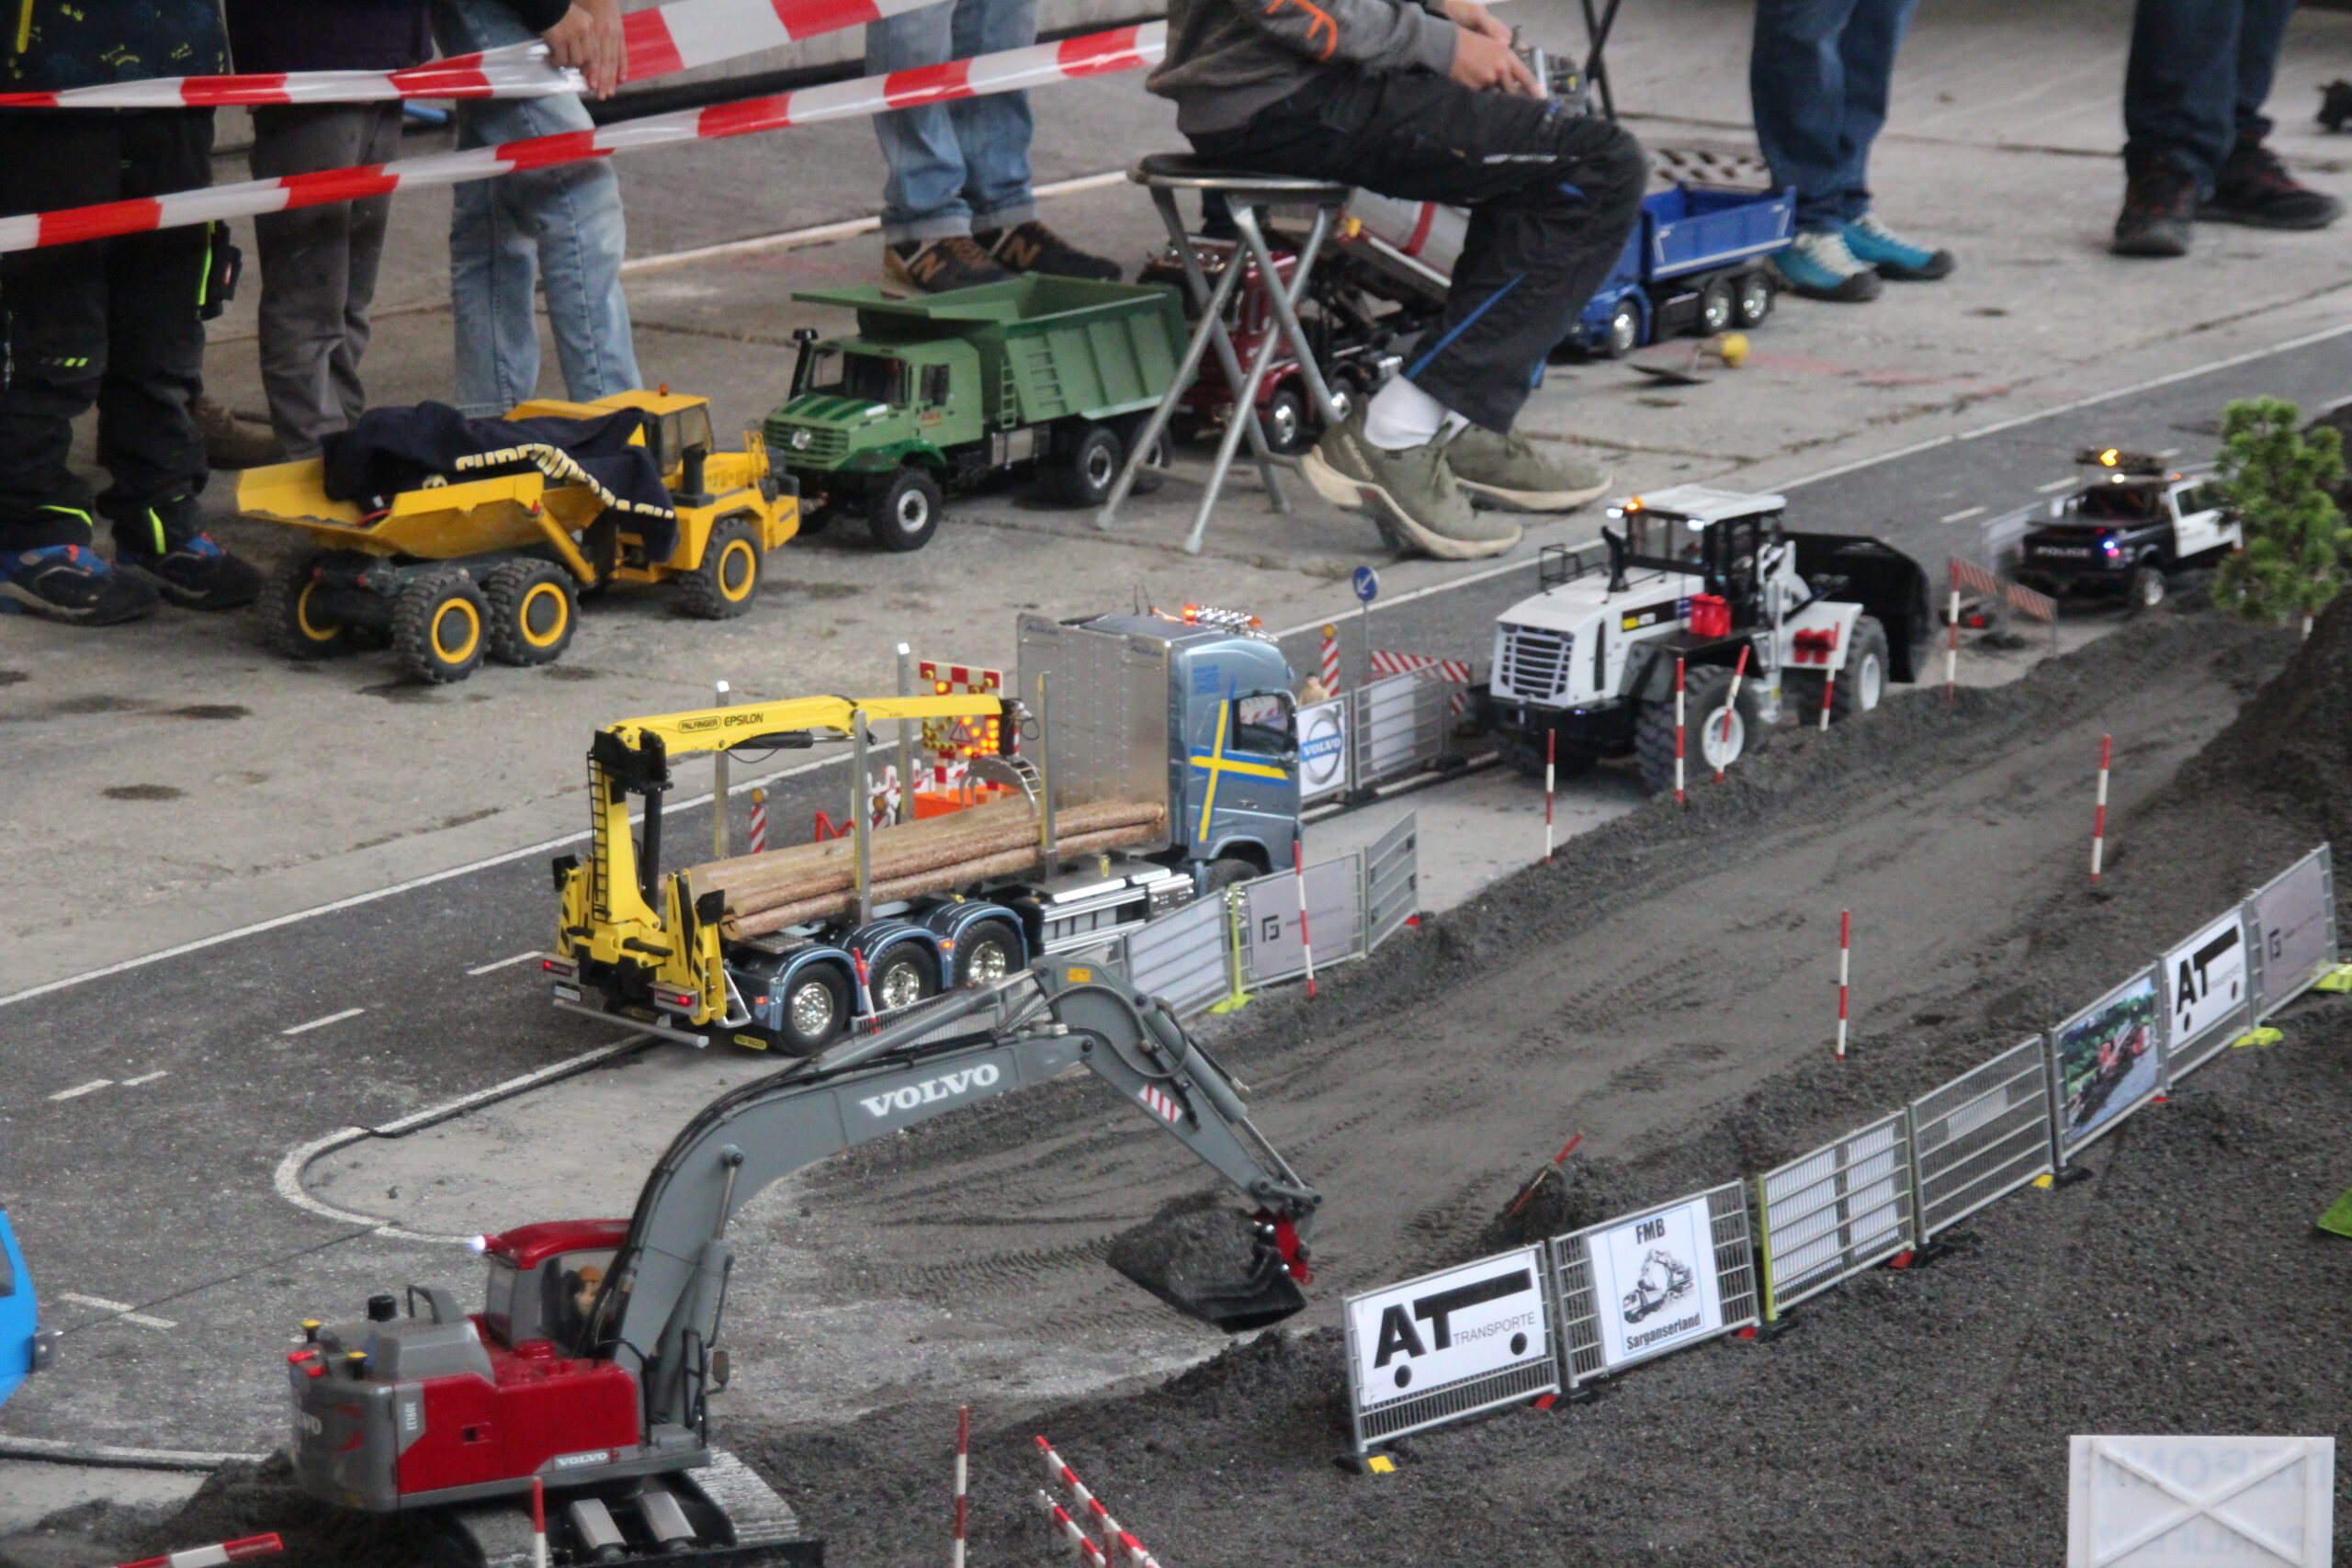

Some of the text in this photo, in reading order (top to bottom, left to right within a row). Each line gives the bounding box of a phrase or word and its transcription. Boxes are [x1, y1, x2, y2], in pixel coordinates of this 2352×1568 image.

[682, 713, 763, 730] PALFINGER EPSILON
[1303, 738, 1341, 756] VOLVO
[2177, 924, 2239, 1015] AT
[860, 1064, 1000, 1117] VOLVO
[1635, 1218, 1666, 1245] FMB
[1374, 1268, 1532, 1369] AT
[1453, 1312, 1535, 1345] TRANSPORTE
[1626, 1312, 1701, 1349] Sarganserland
[558, 1451, 608, 1466] VOLVO
